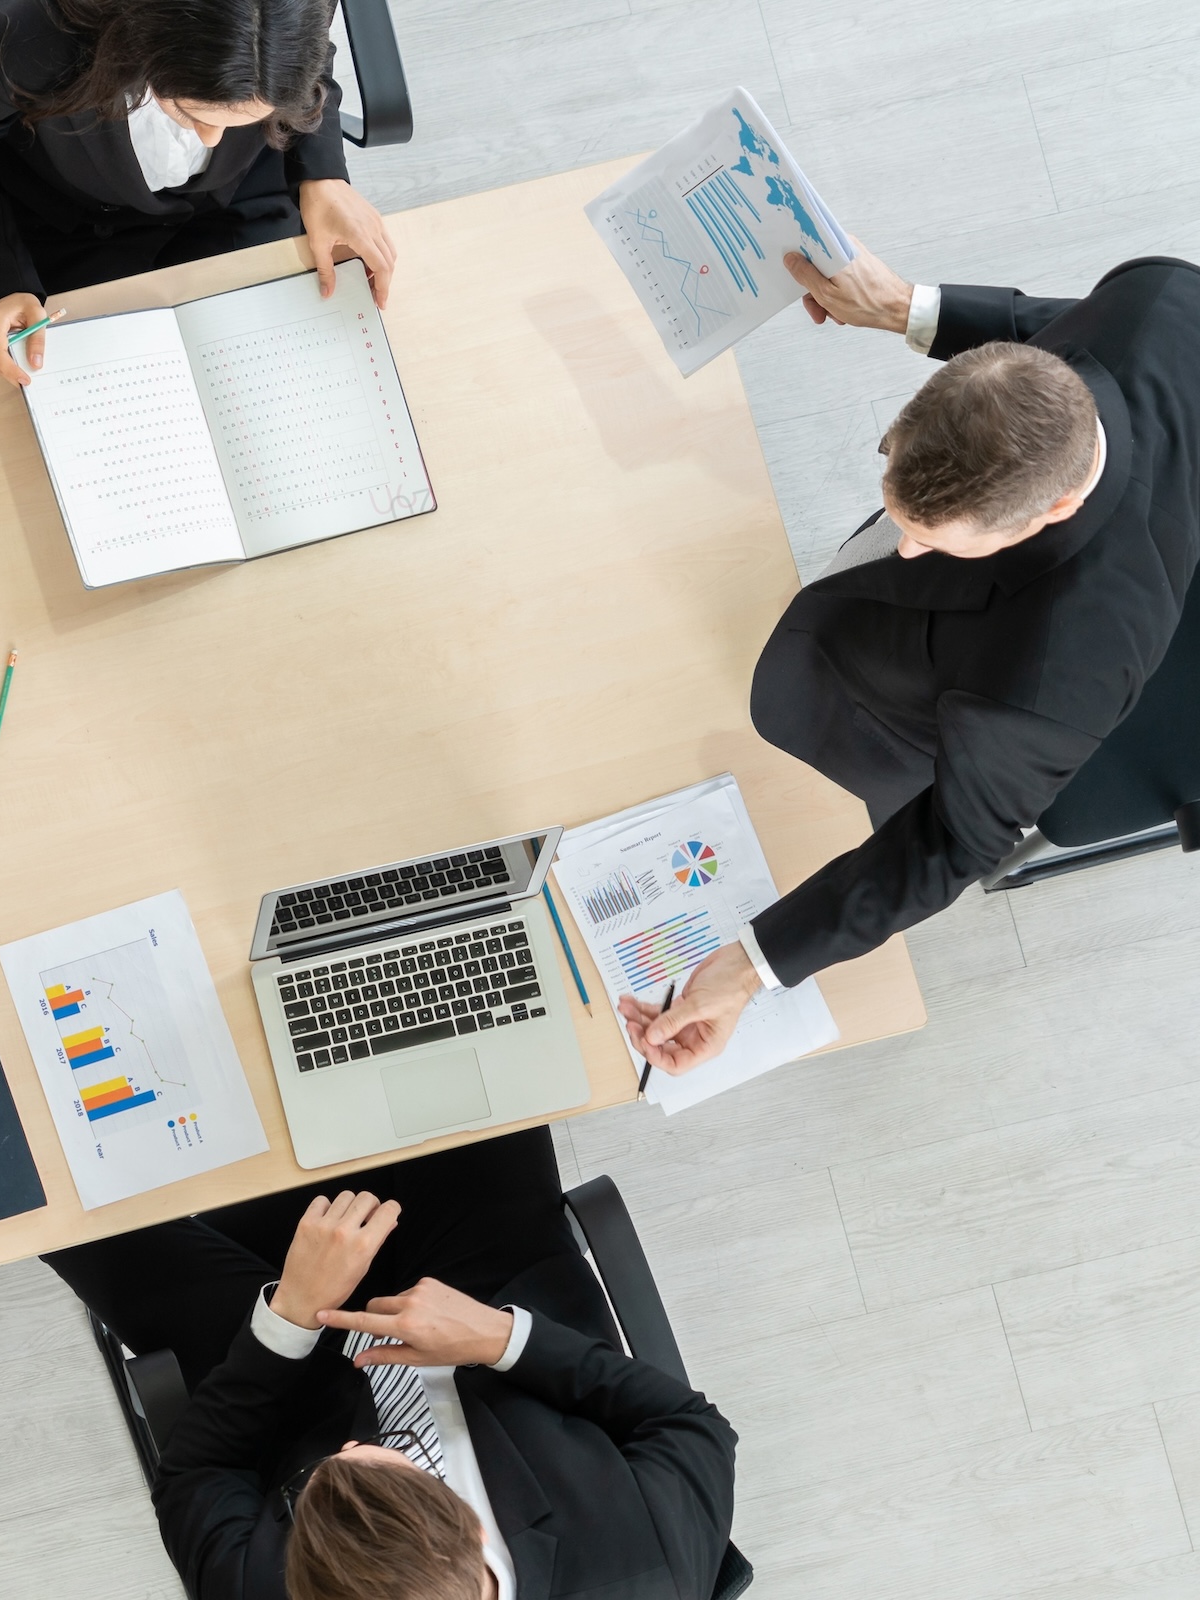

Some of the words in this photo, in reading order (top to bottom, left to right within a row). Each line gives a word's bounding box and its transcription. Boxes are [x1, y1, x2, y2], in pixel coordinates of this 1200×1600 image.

[357, 312, 365, 320] 12
[365, 341, 373, 349] 10
[386, 413, 391, 421] 5
[620, 840, 644, 853] Summary
[643, 831, 662, 843] Report
[148, 928, 159, 947] Sales
[38, 998, 49, 1016] 2016
[55, 1047, 66, 1064] 2017
[73, 1100, 84, 1117] 2018
[171, 1128, 180, 1147] Product
[182, 1125, 191, 1144] Product
[193, 1121, 202, 1140] Product
[95, 1143, 105, 1160] Year
